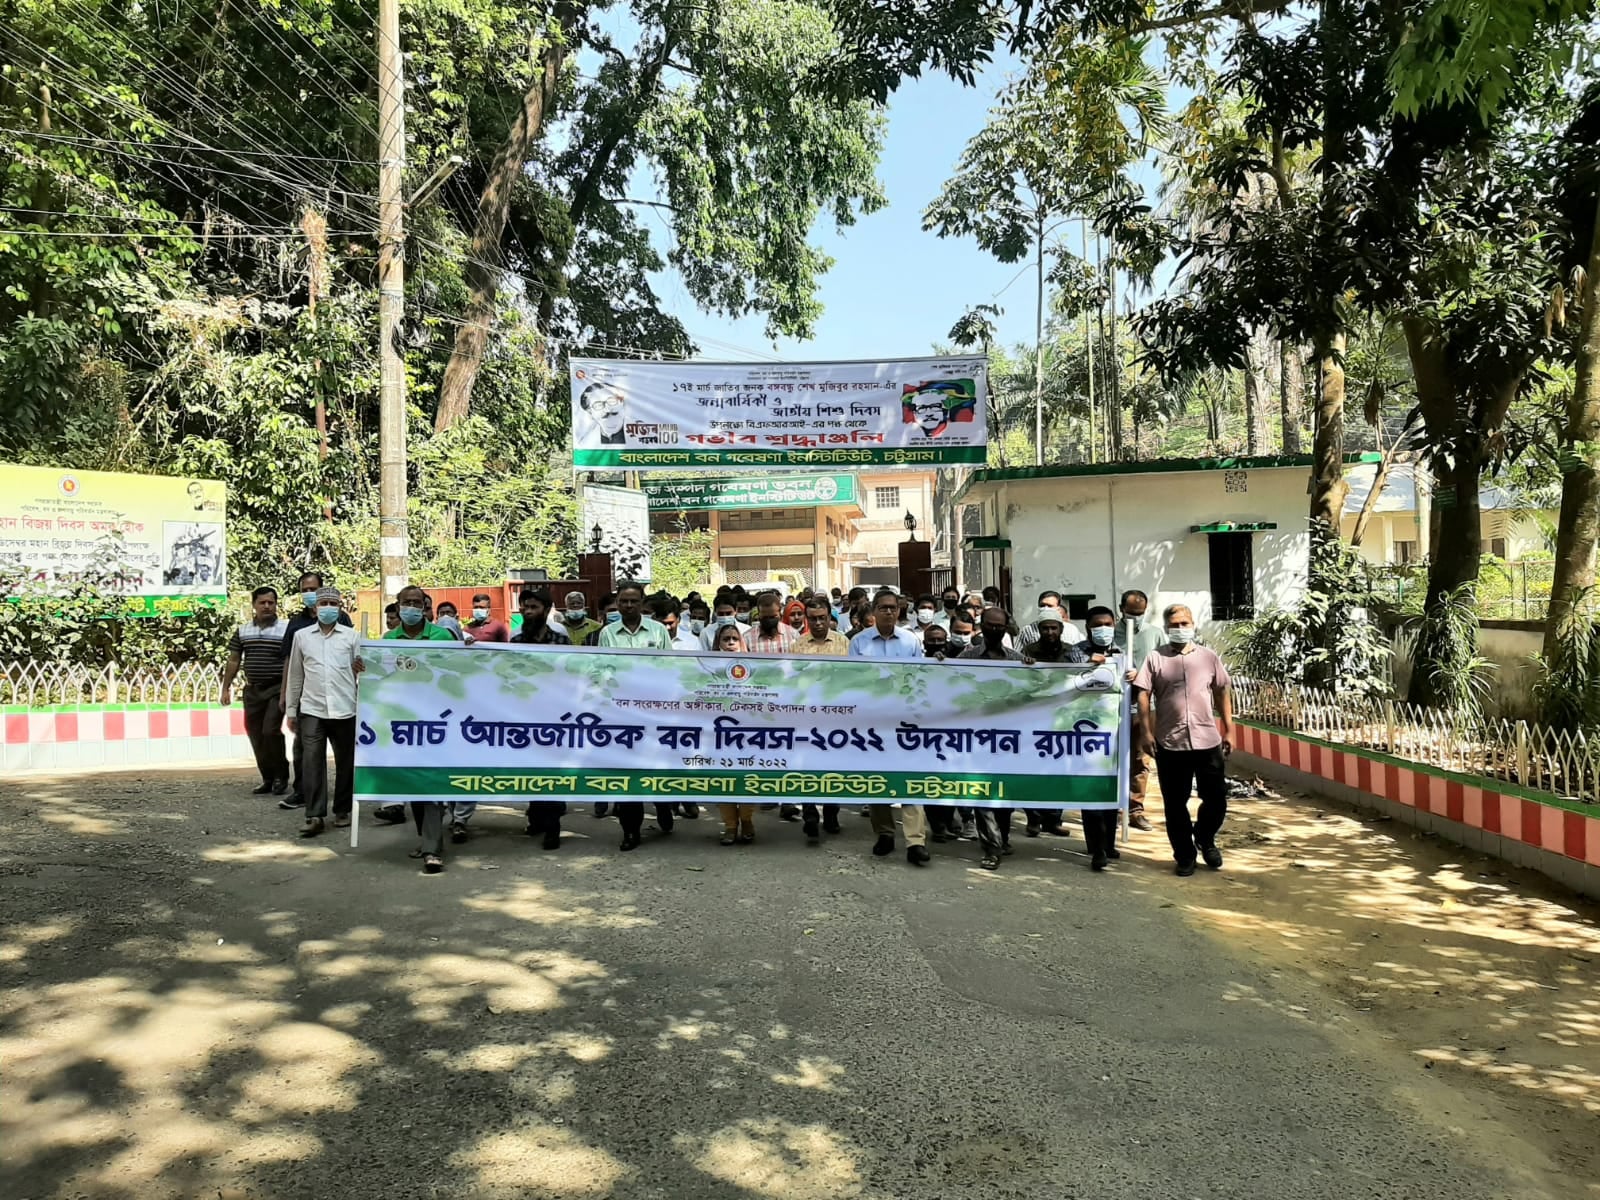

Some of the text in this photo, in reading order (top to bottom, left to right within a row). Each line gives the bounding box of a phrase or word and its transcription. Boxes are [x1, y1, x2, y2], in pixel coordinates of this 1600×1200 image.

[673, 382, 693, 393] ১৭ই
[743, 383, 764, 392] জনক
[798, 383, 816, 392] শেখ
[818, 381, 848, 393] মুজিবুর
[816, 401, 845, 416] শিশু
[850, 401, 881, 416] দিবস
[685, 429, 884, 447] গভীর শ্রদ্ধাঞ্জলি
[619, 452, 689, 464] বাংলাদেশ
[695, 452, 720, 463] বন
[726, 452, 783, 464] গবেষণা
[634, 698, 680, 710] সংরক্ষণের
[729, 700, 763, 713] টেকসই
[767, 702, 805, 713] উৎপাদন
[811, 705, 817, 714] ও
[391, 709, 453, 747] মার্চ
[460, 711, 645, 750] আন্তর্জাতিক
[656, 725, 703, 750] বন
[714, 715, 885, 752] দিবস-২০২২
[720, 757, 733, 768] ২১
[737, 754, 754, 767] মার্চ
[758, 758, 787, 768] ২০২২
[449, 774, 577, 793] বাংলাদেশ
[585, 775, 630, 792] বন
[639, 776, 736, 793] গবেষণা
[744, 773, 897, 796] ইনস্টিটিউট,
